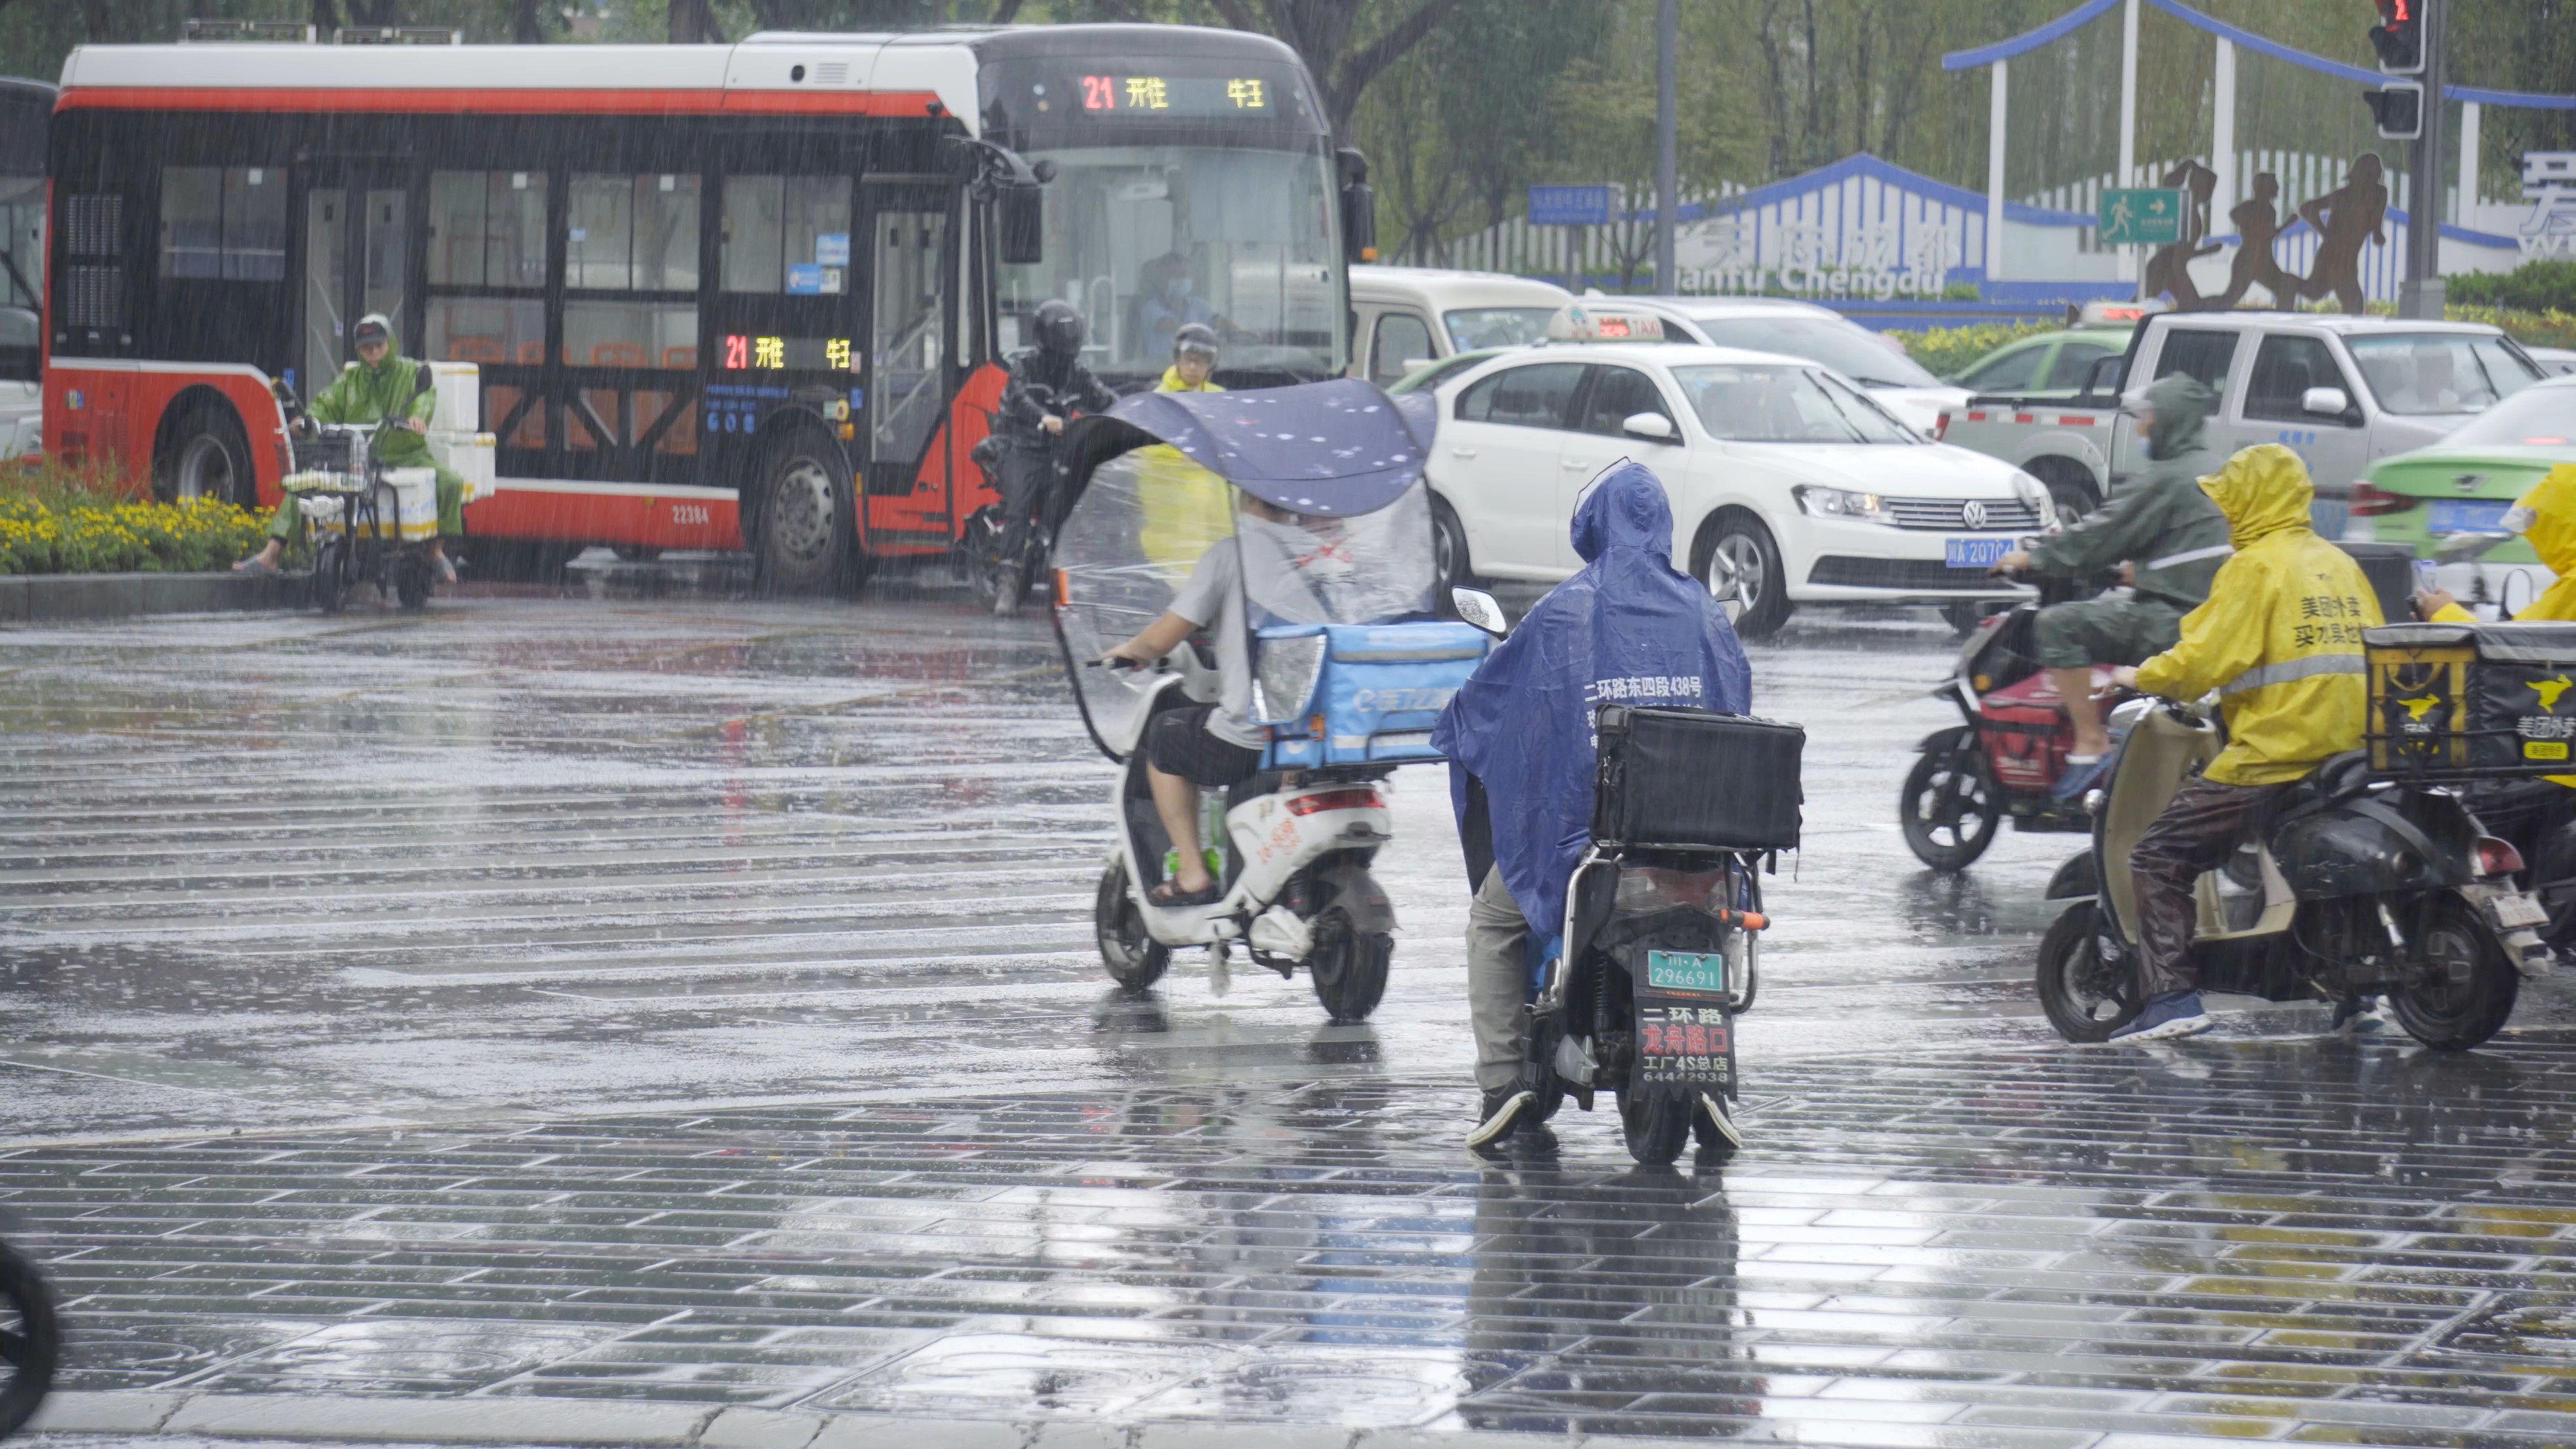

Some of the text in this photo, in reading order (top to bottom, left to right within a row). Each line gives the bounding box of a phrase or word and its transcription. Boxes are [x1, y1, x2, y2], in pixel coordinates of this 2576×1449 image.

[1083, 75, 1114, 109] 21
[1778, 263, 1945, 302] Chengdu
[726, 335, 747, 369] 21
[1584, 676, 1703, 702] 二环路东四段438号
[1654, 967, 1715, 986] 296691
[1643, 1007, 1722, 1025] 二环路
[1642, 1023, 1728, 1055] 龙舟路口
[1643, 1055, 1729, 1071] 工厂4S总店
[1644, 1071, 1729, 1083] 64442938
